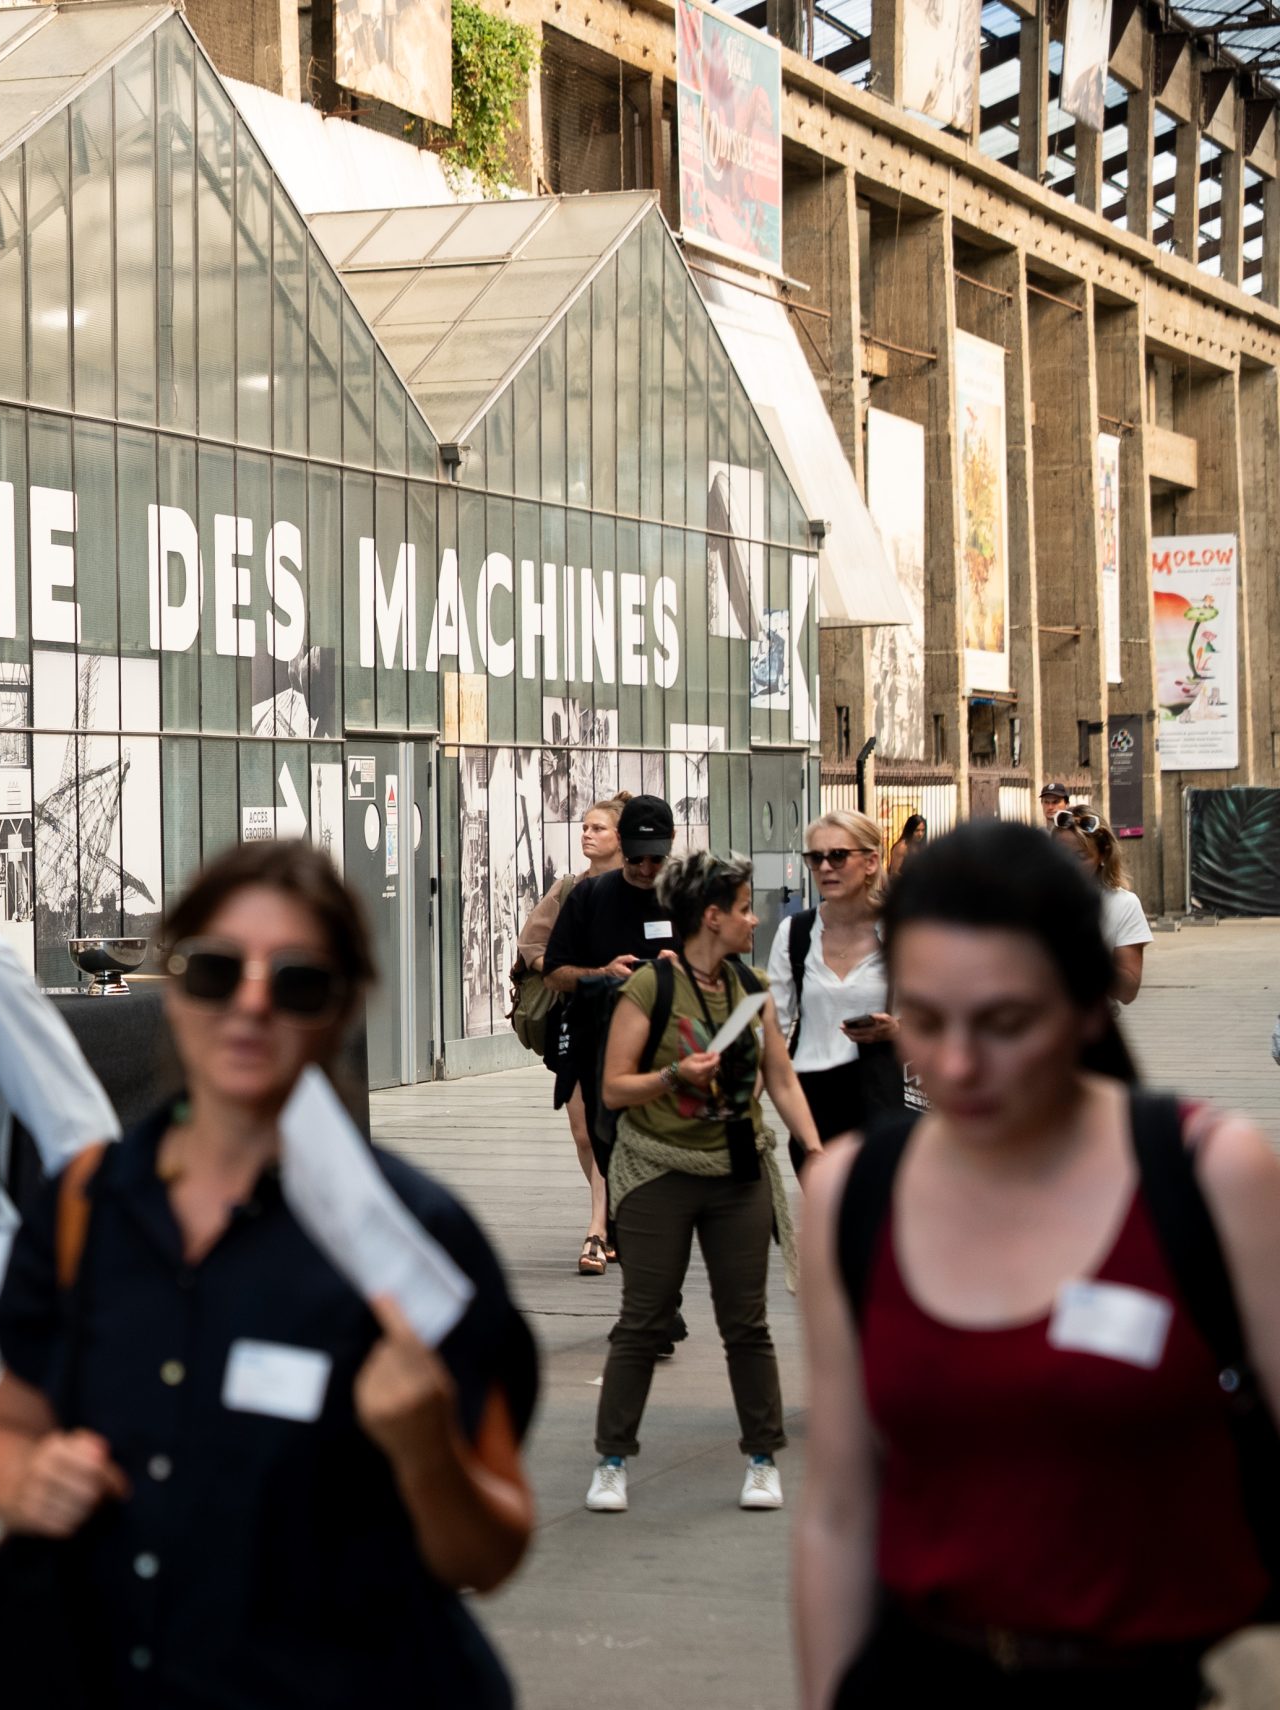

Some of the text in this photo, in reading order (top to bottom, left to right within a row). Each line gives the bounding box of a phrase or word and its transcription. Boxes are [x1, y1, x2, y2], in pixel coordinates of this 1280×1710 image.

[148, 504, 305, 661] DES
[359, 537, 680, 688] MACHINES
[249, 808, 268, 823] ACCÈS
[245, 828, 272, 839] GROUPES
